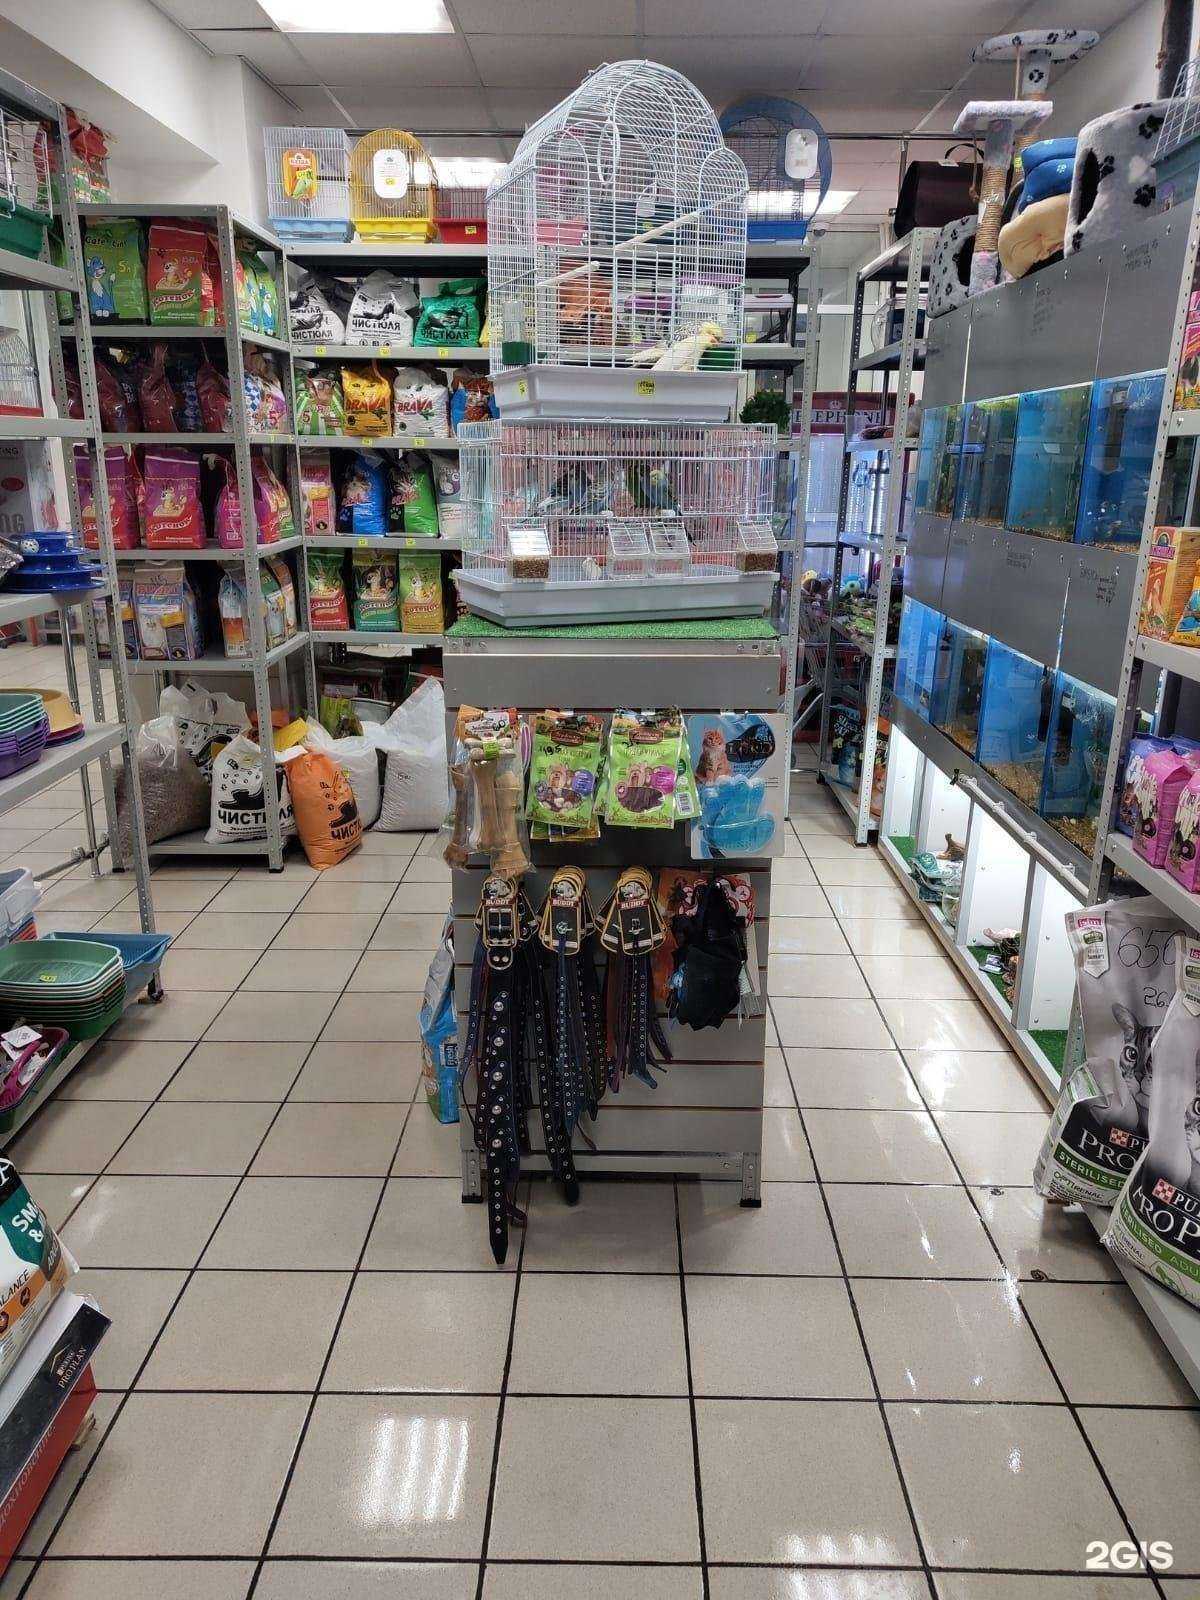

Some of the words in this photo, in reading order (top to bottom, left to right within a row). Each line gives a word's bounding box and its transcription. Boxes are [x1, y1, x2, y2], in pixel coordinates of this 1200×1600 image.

[352, 318, 401, 332] ЧИСТЮЛЯ
[291, 329, 333, 340] ЧИСТЮЛЯ
[421, 329, 470, 341] ЧИСТЮЛЯ
[397, 399, 433, 412] BRAVA
[218, 805, 293, 825] ЧИСТЛЯ
[57, 1367, 74, 1388] PRO
[68, 1345, 88, 1370] PLAN
